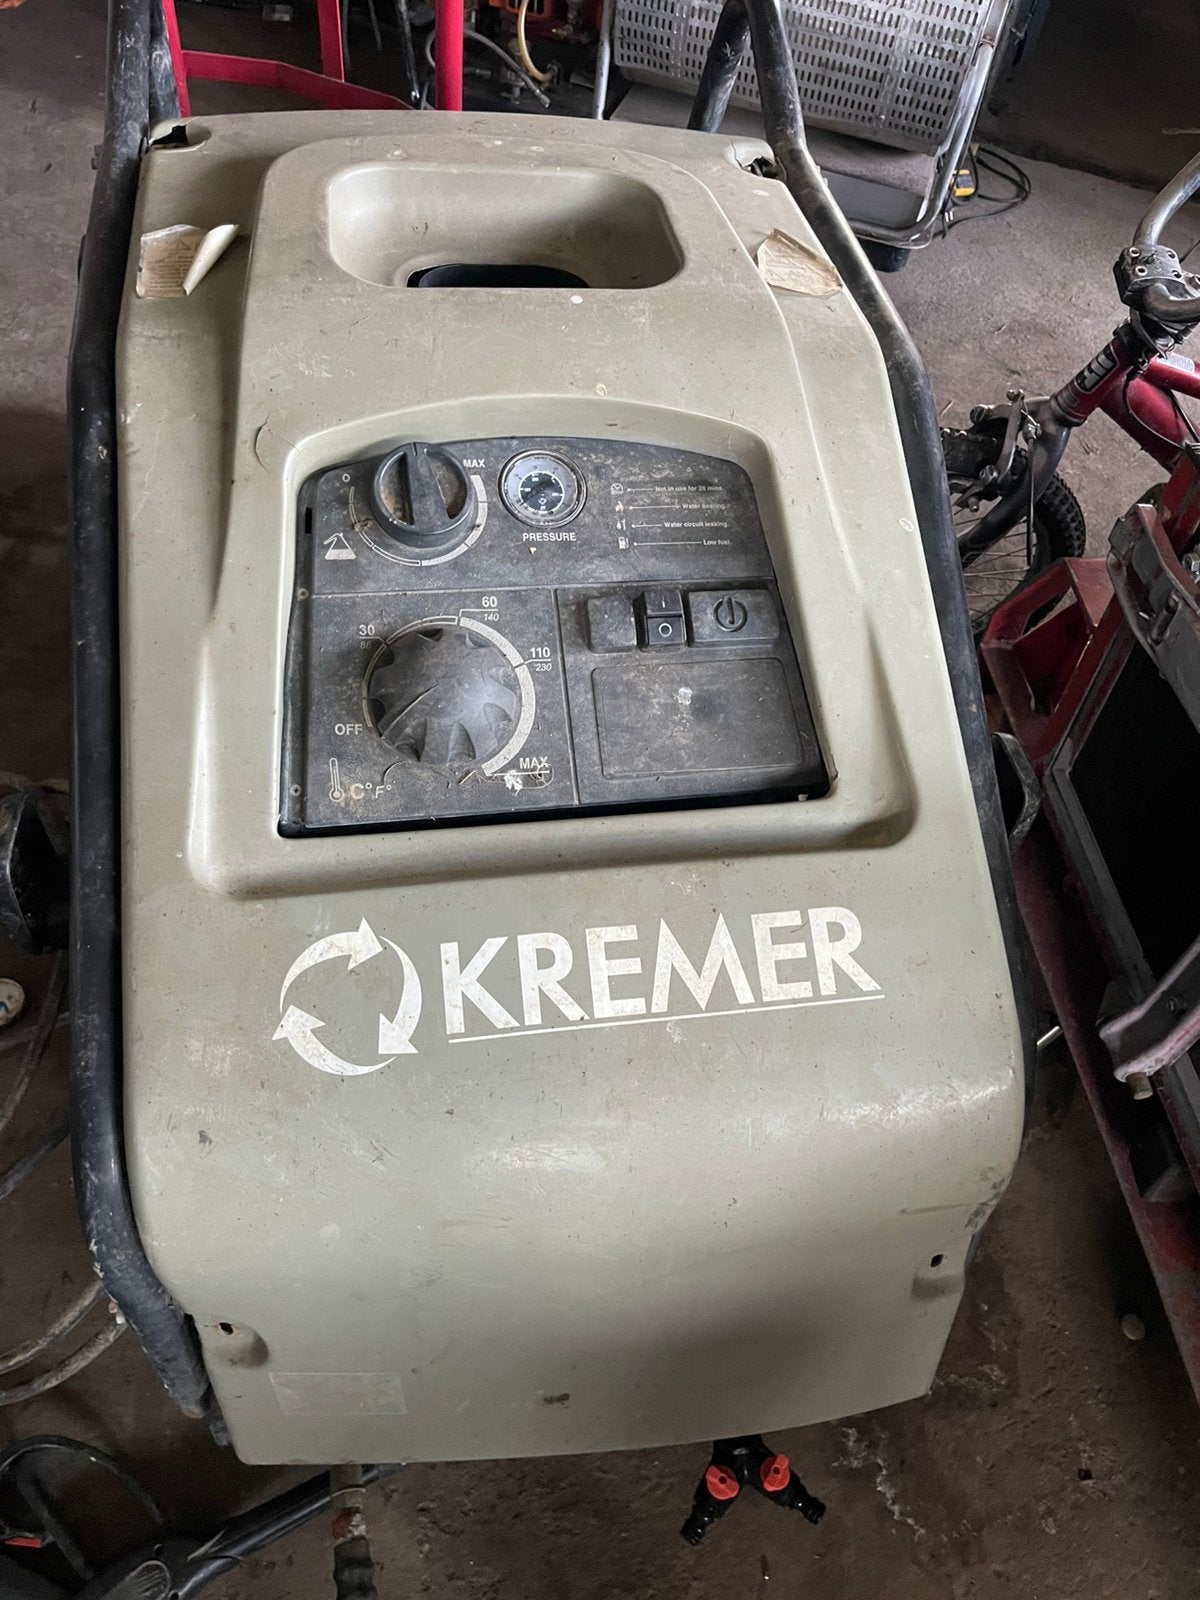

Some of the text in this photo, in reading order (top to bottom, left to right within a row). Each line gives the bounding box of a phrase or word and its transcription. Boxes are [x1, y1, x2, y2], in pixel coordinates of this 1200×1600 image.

[463, 459, 485, 468] MAX
[522, 532, 577, 542] PRESSURE
[482, 596, 498, 608] 60
[483, 613, 500, 621] 140
[359, 624, 375, 636] 30
[530, 647, 551, 658] 110
[535, 663, 552, 671] 230
[334, 723, 363, 736] OFF
[519, 756, 549, 769] MAX
[440, 906, 882, 1035] KREMER
